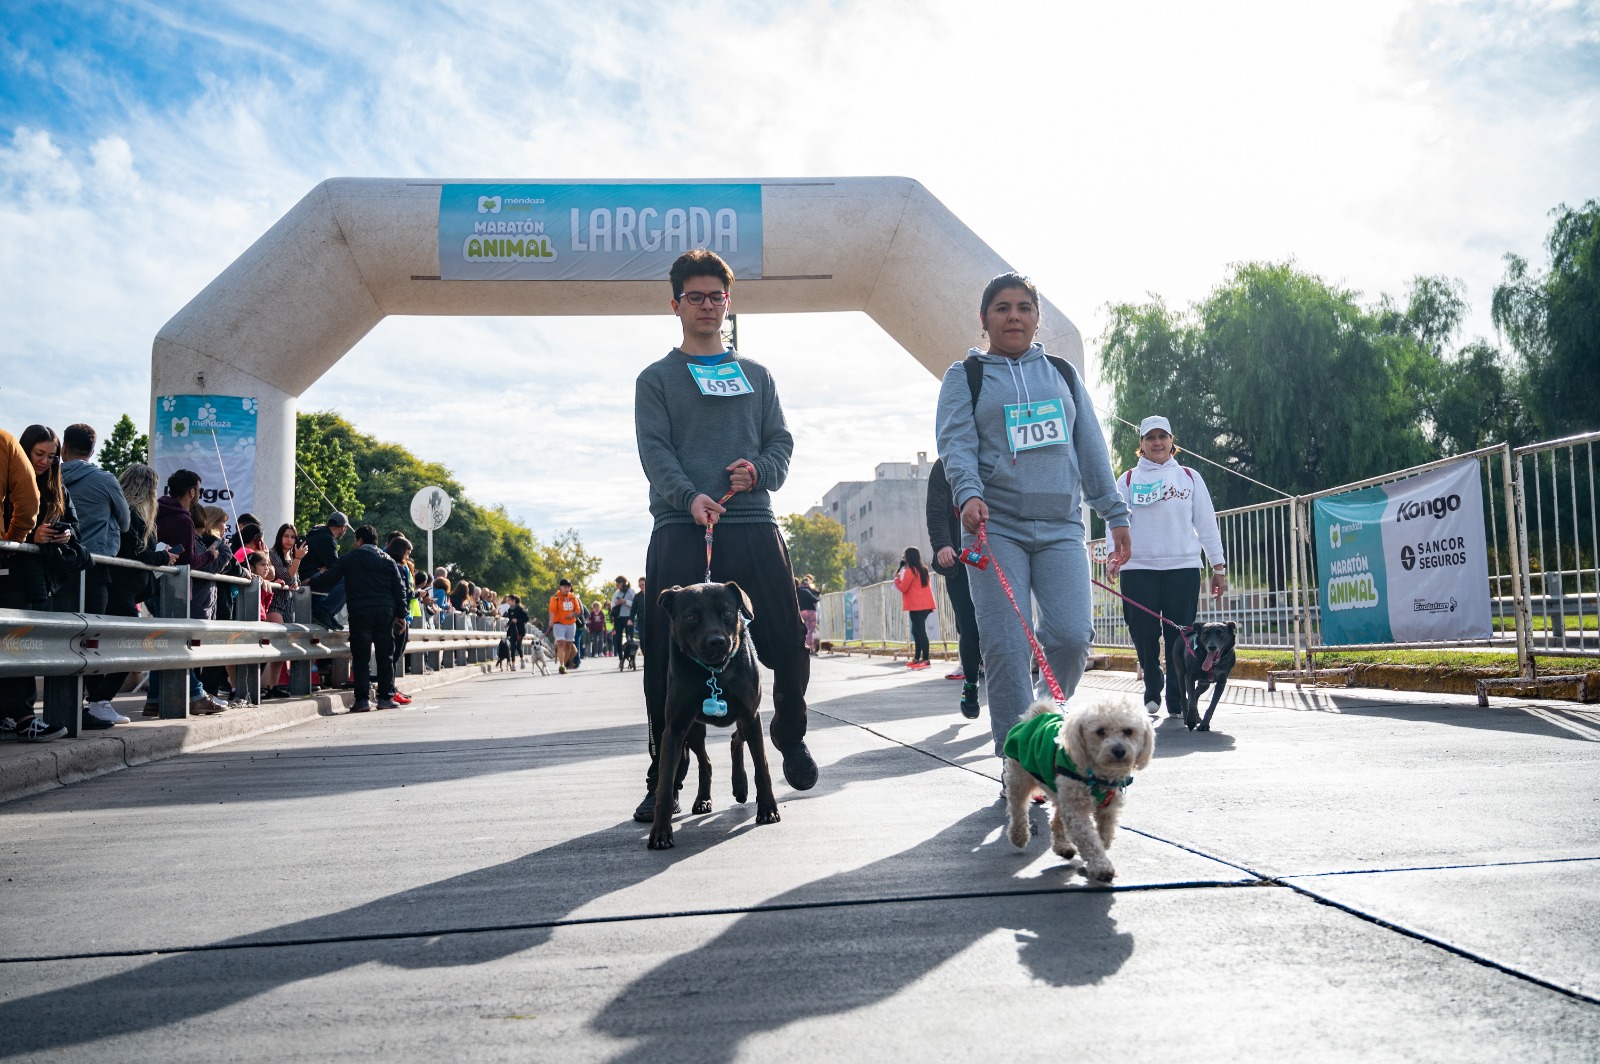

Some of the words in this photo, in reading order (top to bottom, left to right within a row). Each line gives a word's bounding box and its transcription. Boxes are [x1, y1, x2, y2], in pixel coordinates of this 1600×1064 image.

[504, 197, 545, 205] mendoza
[474, 218, 544, 233] MARATÓN
[570, 207, 738, 252] LARGADA
[467, 238, 554, 258] ANIMAL
[706, 379, 741, 393] 695
[191, 420, 232, 428] mendoza
[1017, 420, 1059, 445] 703
[1137, 490, 1158, 503] 565
[1396, 494, 1461, 522] Kongo
[1417, 537, 1466, 555] SANCOR
[1330, 552, 1369, 576] MARATÓN
[1419, 552, 1466, 570] SEGUROS
[1329, 578, 1376, 605] ANIMAL
